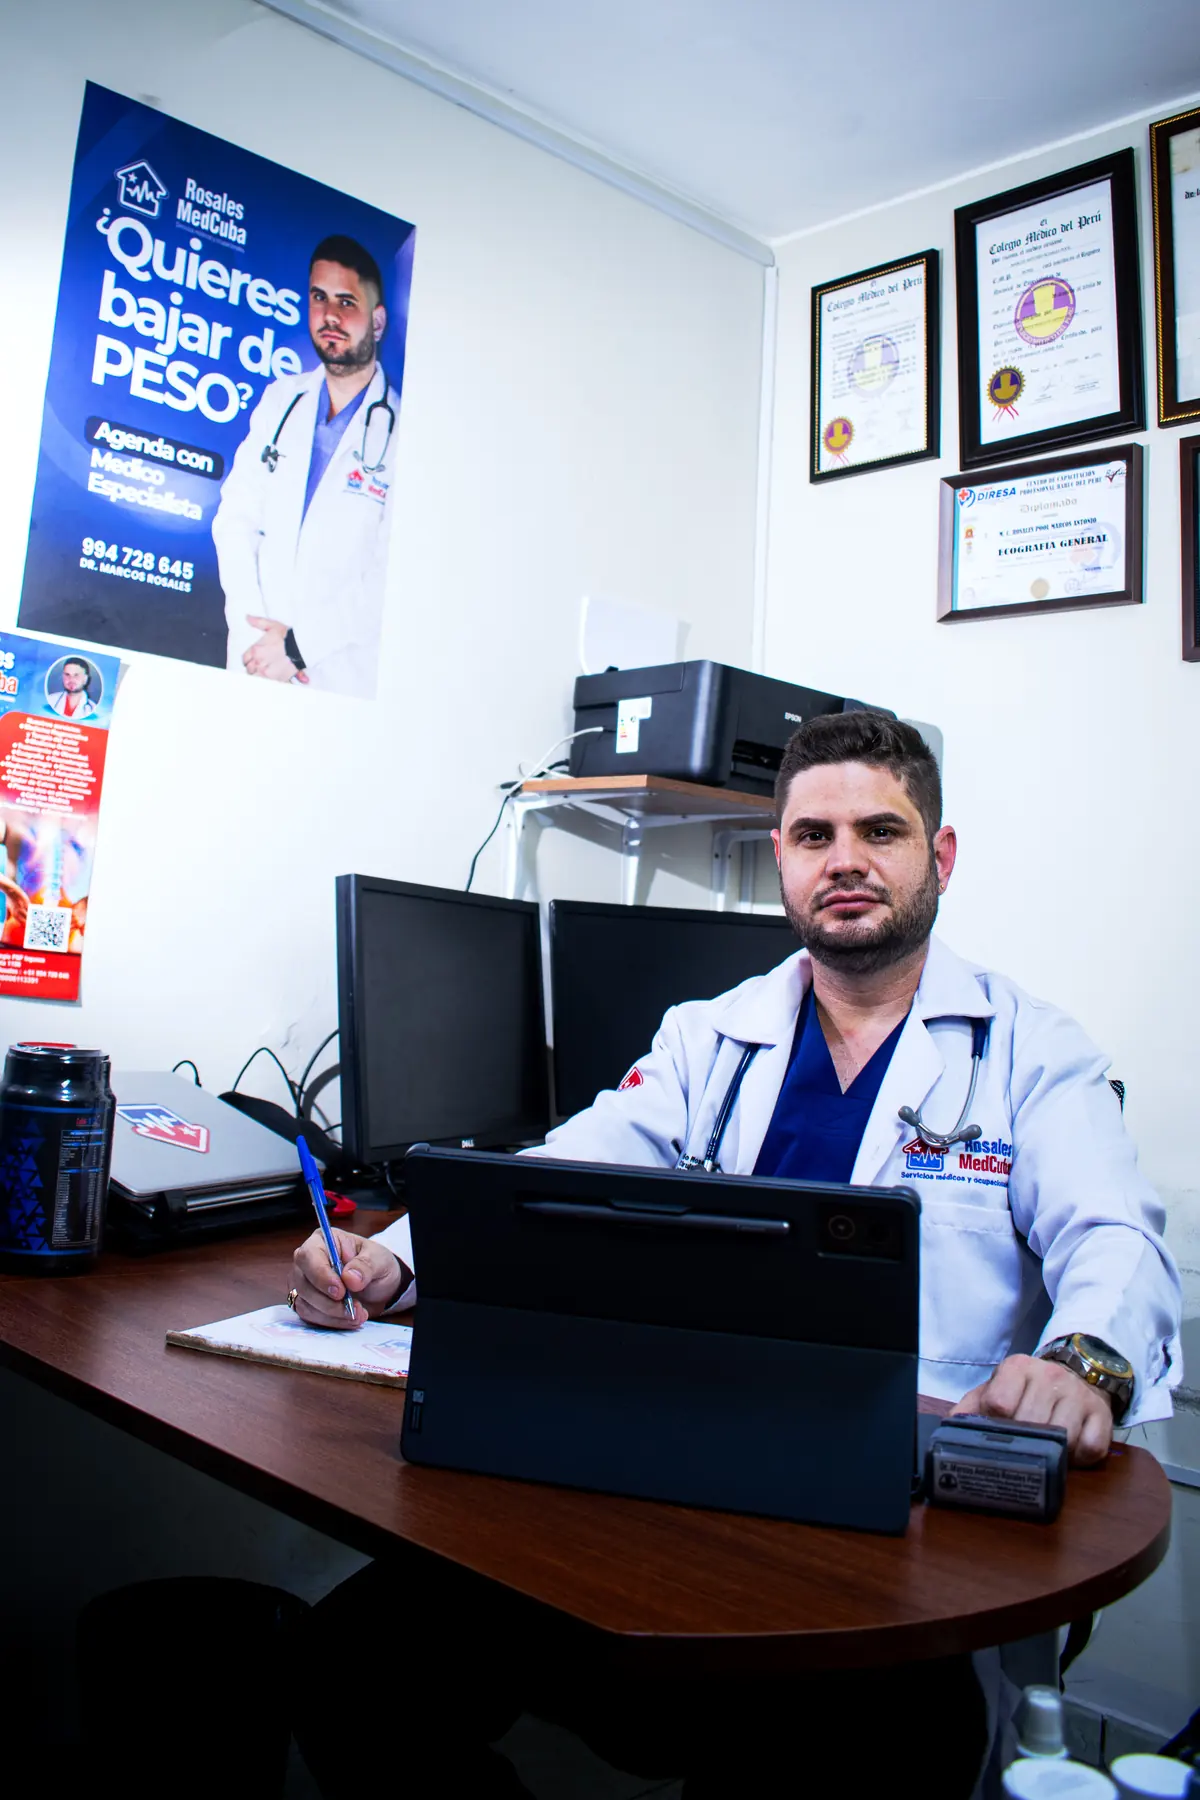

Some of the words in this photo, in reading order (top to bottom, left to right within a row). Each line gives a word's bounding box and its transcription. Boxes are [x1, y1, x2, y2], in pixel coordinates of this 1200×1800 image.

[185, 177, 245, 220] Rosales
[176, 198, 247, 245] MedCuba
[989, 238, 1022, 255] Colegio
[1060, 221, 1073, 233] del
[95, 207, 301, 326] ¿Quieres
[98, 269, 232, 360] bajar
[238, 327, 302, 381] de
[91, 334, 254, 424] PESO?
[93, 421, 175, 462] Agenda
[176, 449, 214, 473] con
[87, 471, 203, 521] Especialista
[977, 487, 1017, 501] DIRESA
[82, 537, 119, 562] 994
[122, 547, 155, 571] 728
[158, 556, 194, 580] 645
[1060, 534, 1109, 548] GENERAL
[79, 557, 98, 571] DR.
[99, 562, 146, 582] MARCOS
[146, 574, 192, 593] ROSALES
[784, 711, 802, 723] EPSON
[901, 1171, 934, 1180] Servicios
[936, 1173, 966, 1182] médicos
